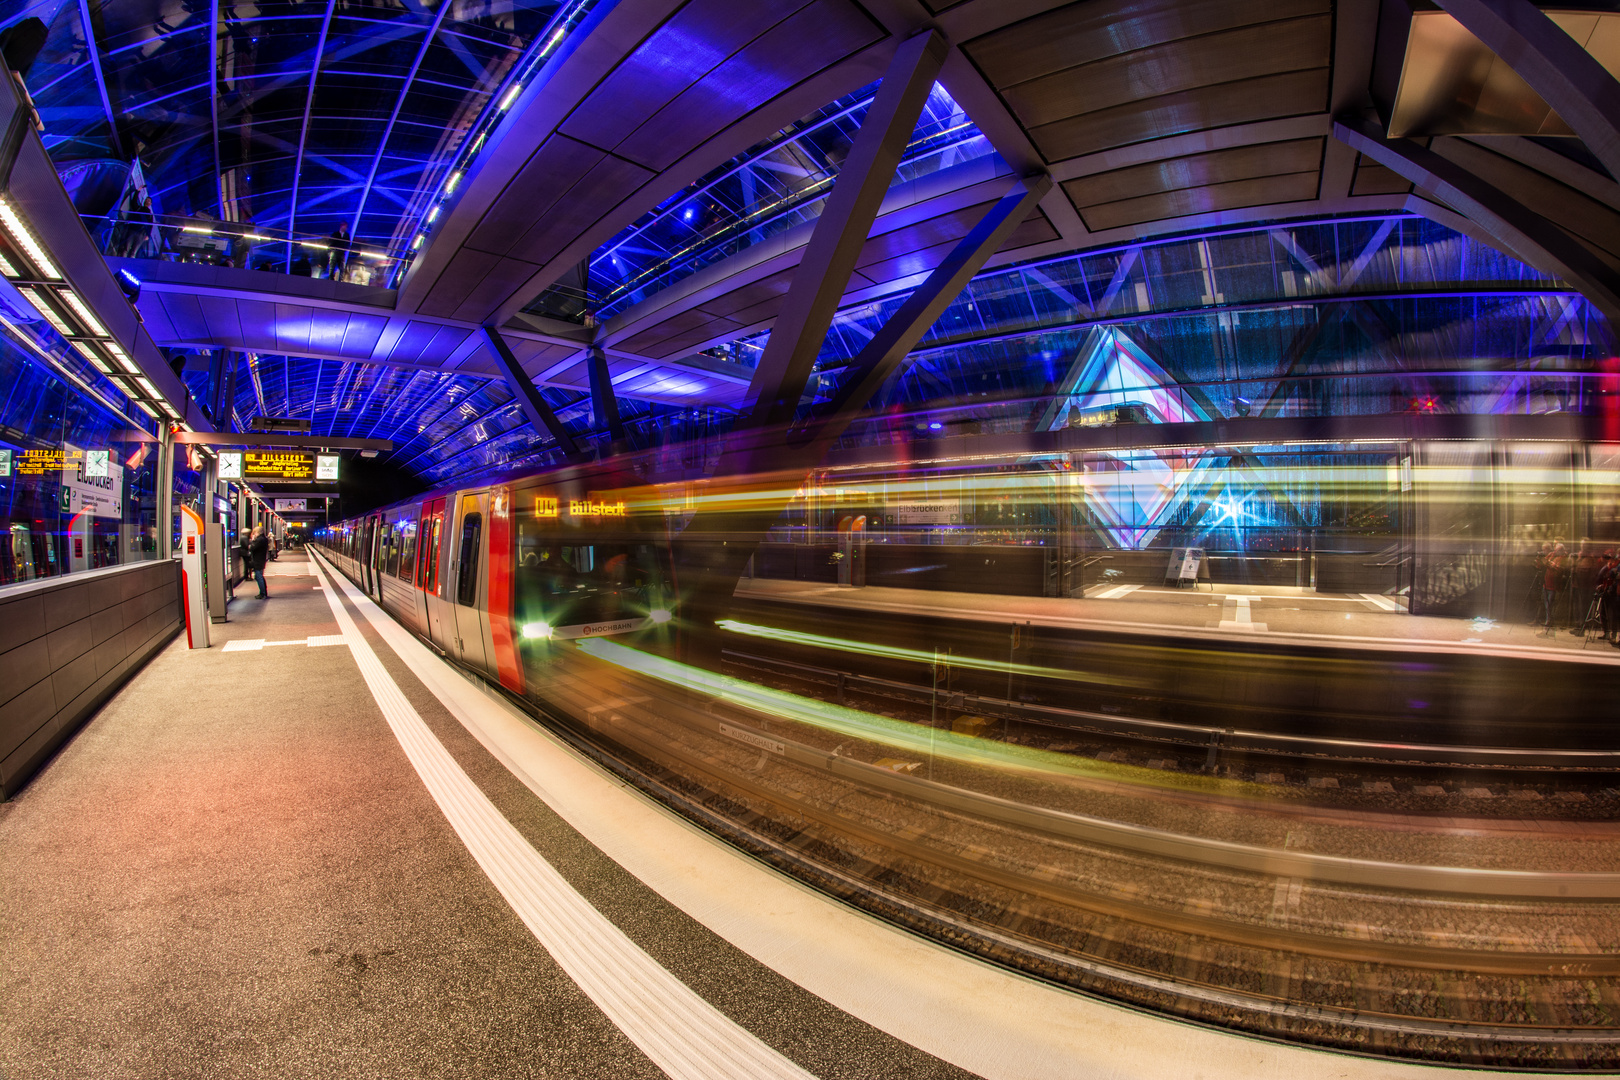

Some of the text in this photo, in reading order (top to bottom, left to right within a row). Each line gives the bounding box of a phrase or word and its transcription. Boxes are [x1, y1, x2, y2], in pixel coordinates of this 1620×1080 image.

[537, 499, 625, 516] U4 Billstedt
[592, 623, 632, 633] HOCHBAHN
[731, 729, 774, 750] KURZZUGHALT
